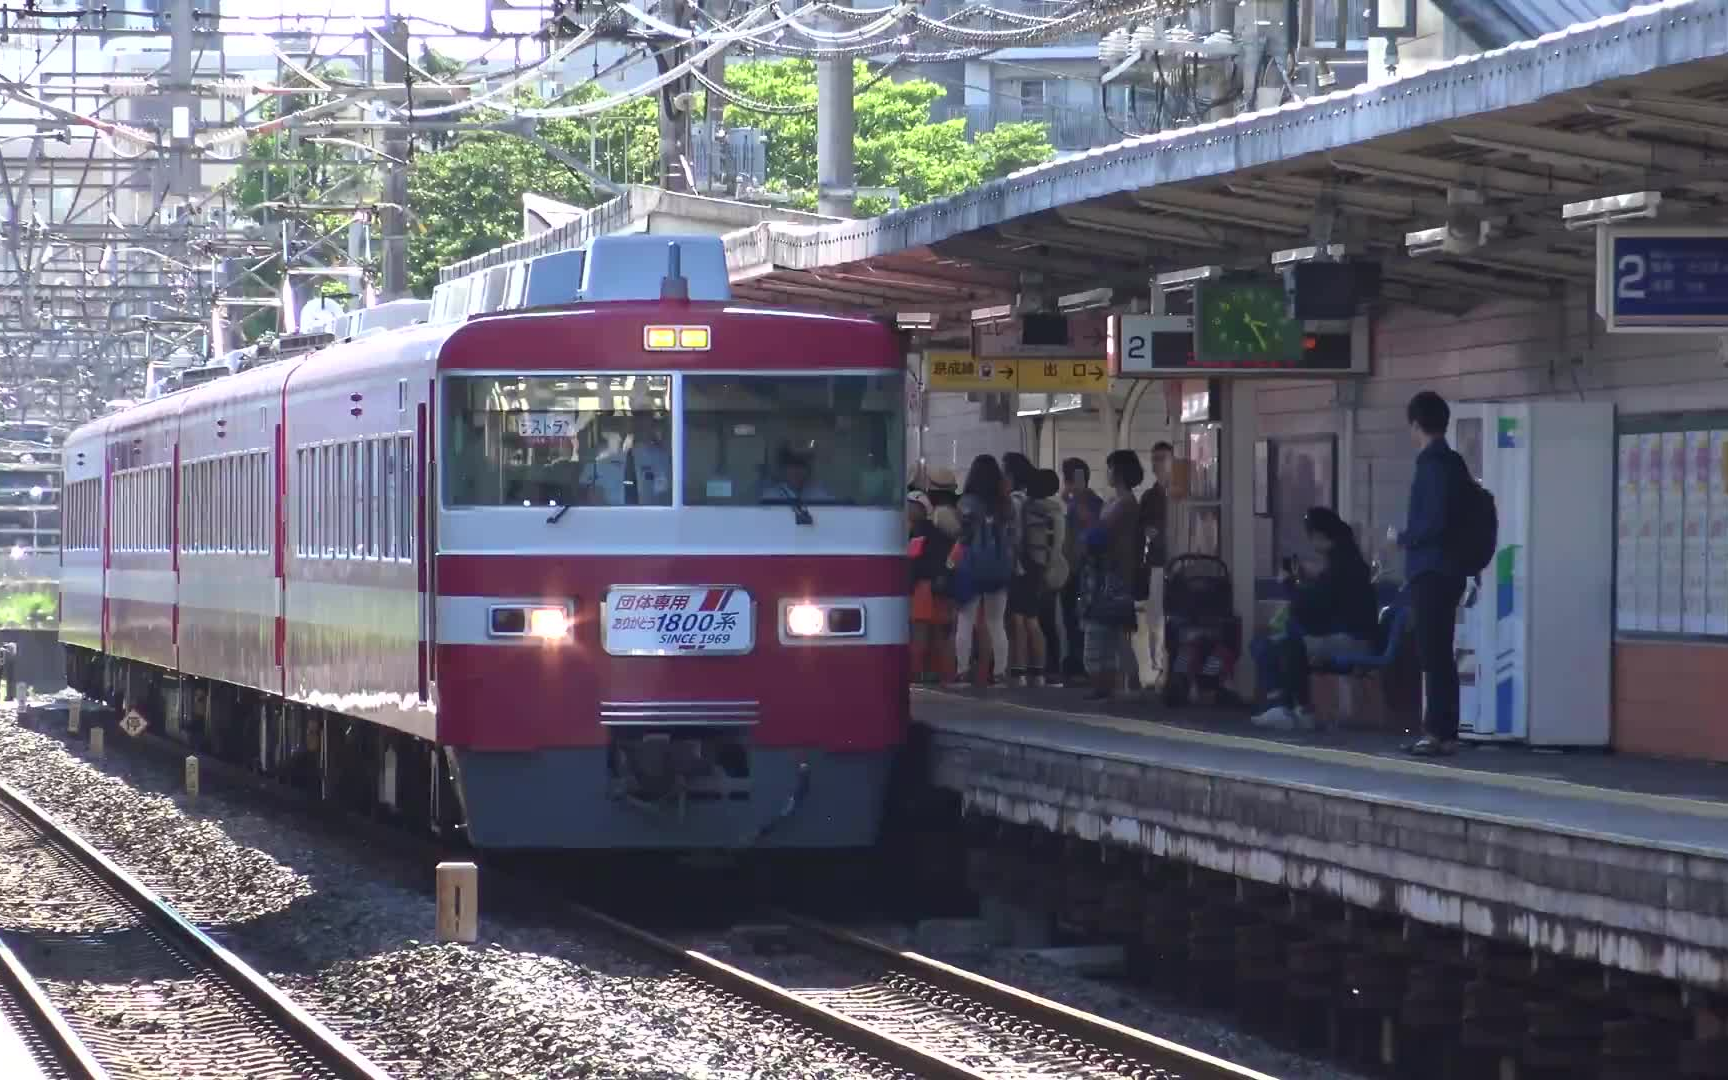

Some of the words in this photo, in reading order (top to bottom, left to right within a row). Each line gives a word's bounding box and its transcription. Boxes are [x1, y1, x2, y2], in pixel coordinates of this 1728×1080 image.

[1617, 254, 1646, 299] 2
[1127, 335, 1146, 359] 2
[1043, 361, 1087, 377] 出口
[614, 594, 691, 611] 団体専用
[656, 611, 740, 633] 1800系
[659, 633, 698, 644] SINCE
[700, 633, 731, 644] 1969
